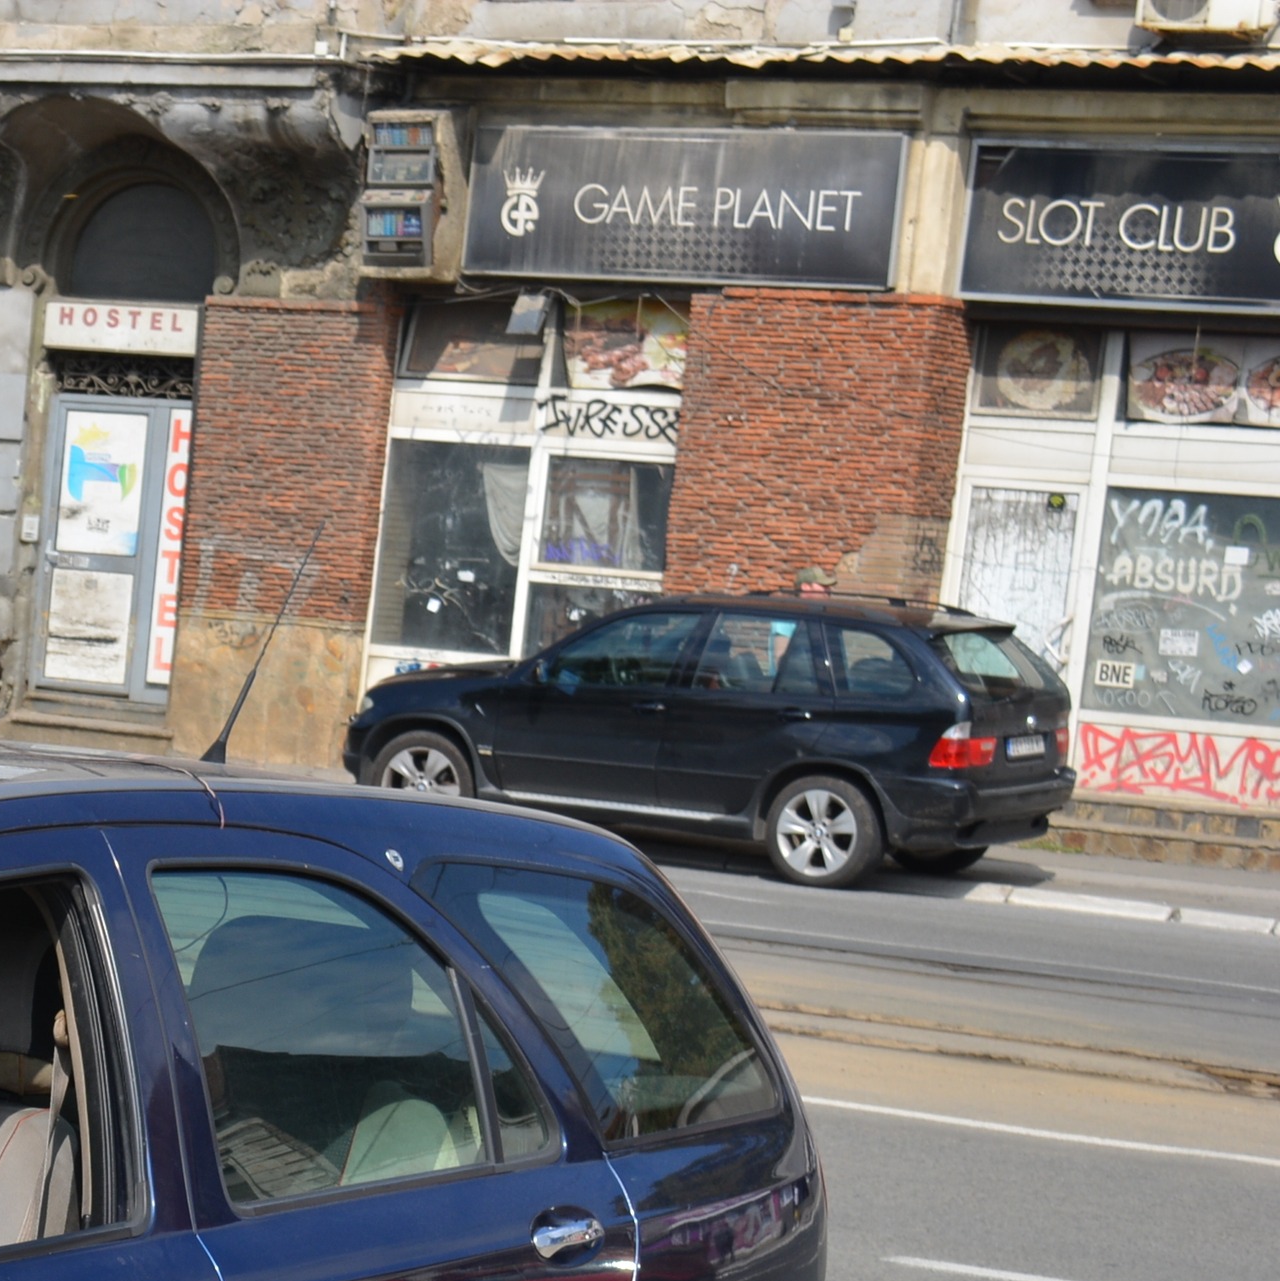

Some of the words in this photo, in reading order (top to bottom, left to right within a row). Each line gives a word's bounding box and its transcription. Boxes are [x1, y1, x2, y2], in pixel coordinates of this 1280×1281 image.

[573, 183, 698, 231] GAME
[714, 189, 863, 232] PLANET
[997, 198, 1105, 247] SLOT
[1119, 204, 1235, 254] CLUB
[59, 307, 183, 331] HOSTEL
[153, 418, 192, 671] HOSTEL
[1106, 555, 1242, 602] ABSURD
[1099, 663, 1132, 684] BNE
